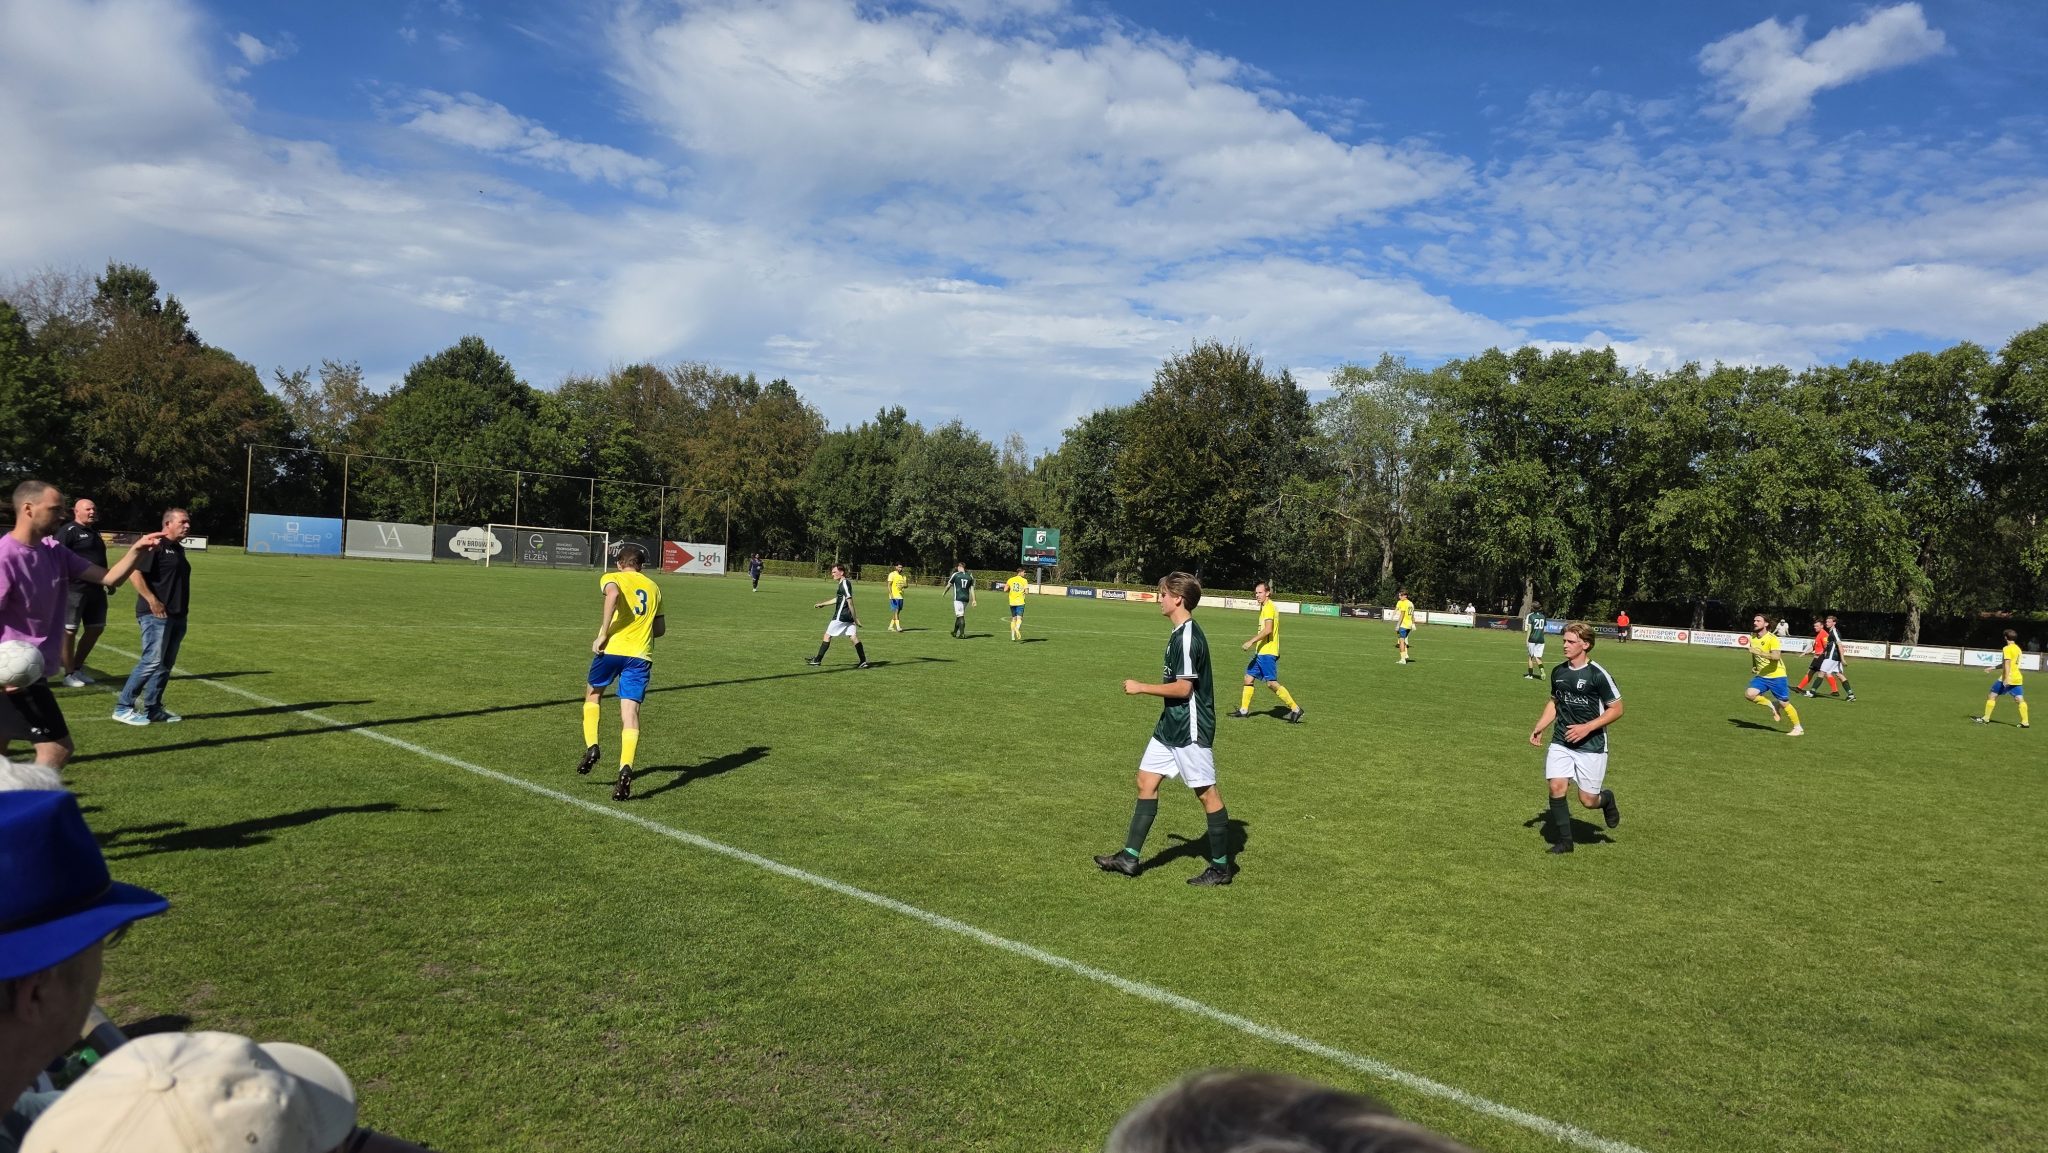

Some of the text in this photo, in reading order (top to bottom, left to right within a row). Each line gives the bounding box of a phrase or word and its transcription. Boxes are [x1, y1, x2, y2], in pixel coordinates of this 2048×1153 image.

[698, 551, 721, 567] bgh
[960, 578, 969, 589] 17
[633, 588, 648, 616] 3
[1533, 618, 1545, 630] 20
